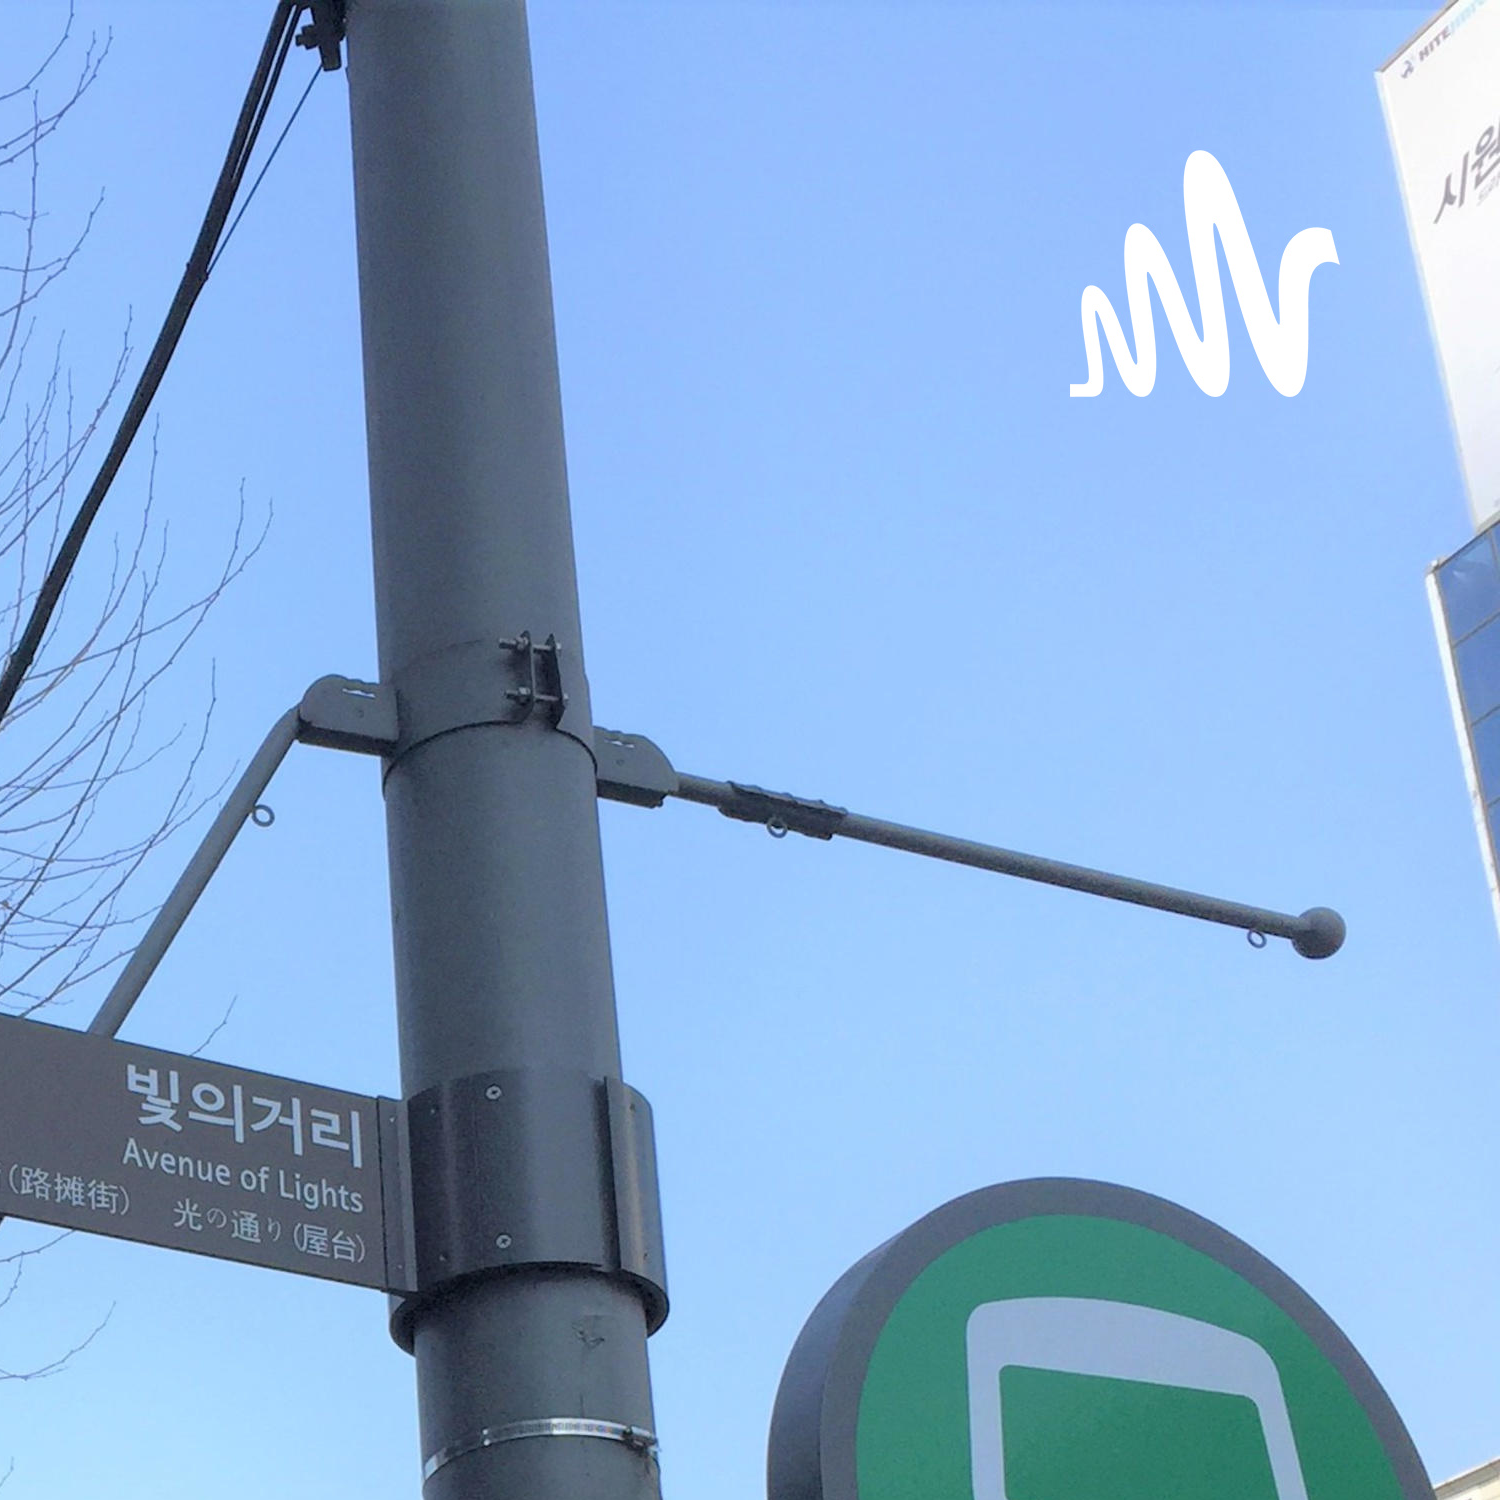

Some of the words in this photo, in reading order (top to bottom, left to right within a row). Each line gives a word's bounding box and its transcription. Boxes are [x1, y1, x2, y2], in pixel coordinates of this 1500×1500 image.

[126, 1063, 363, 1169] 빛의거리
[122, 1136, 231, 1187] Avenue
[239, 1166, 270, 1194] of
[278, 1169, 364, 1214] Lights
